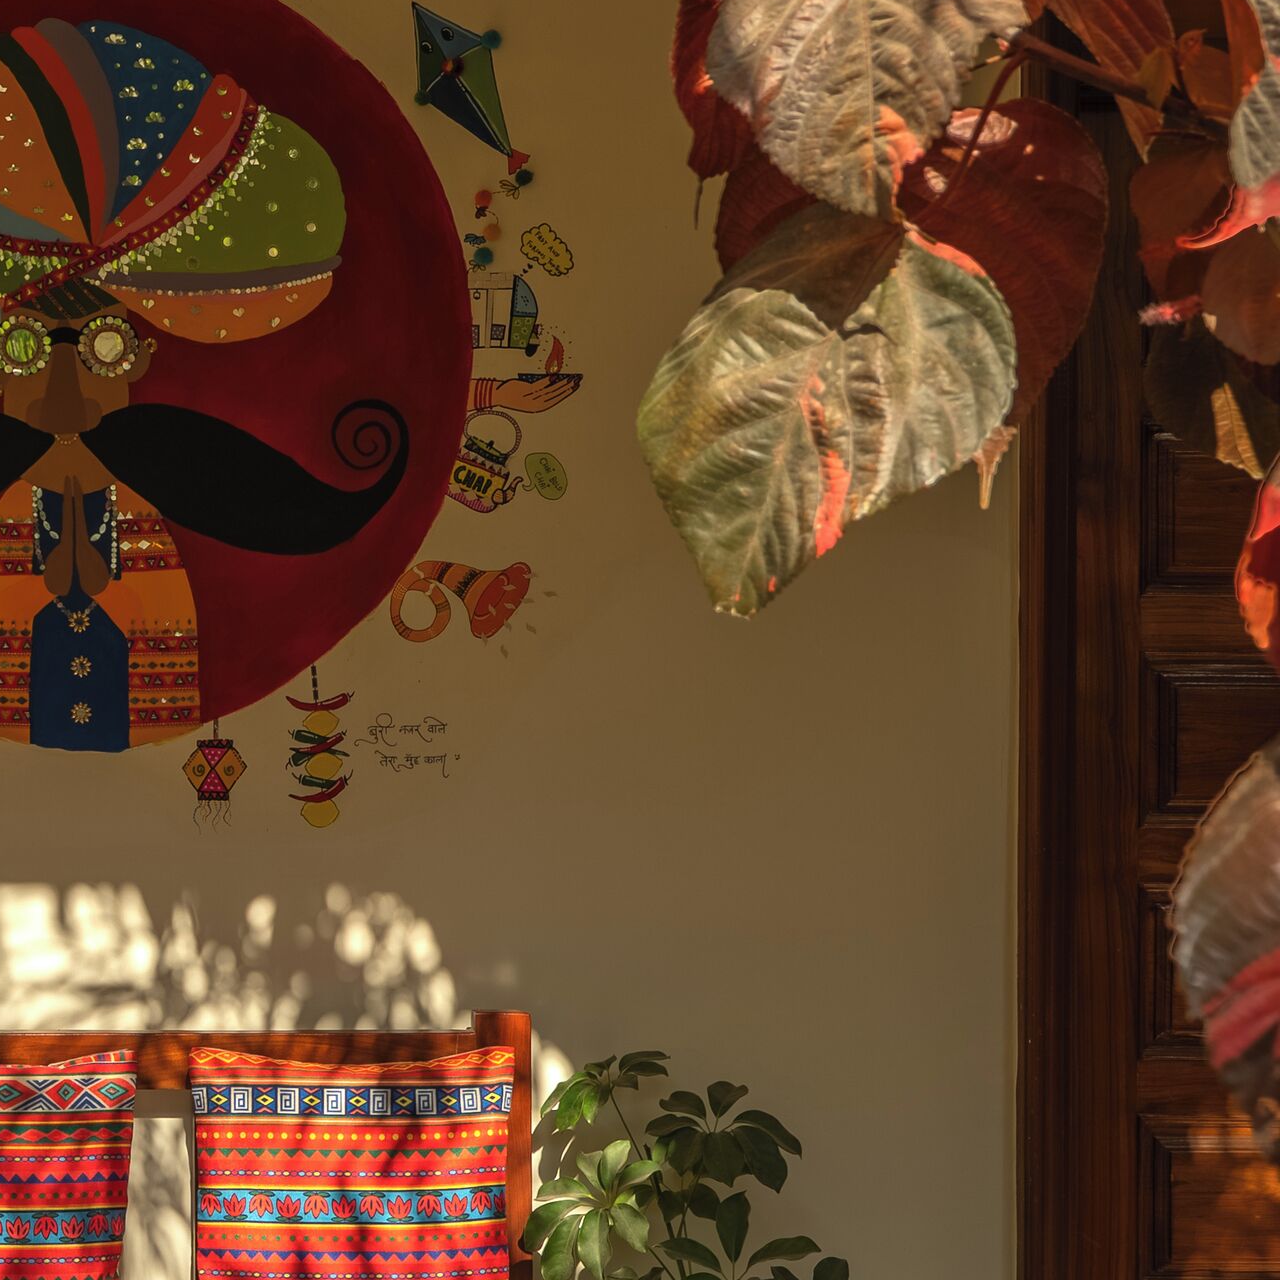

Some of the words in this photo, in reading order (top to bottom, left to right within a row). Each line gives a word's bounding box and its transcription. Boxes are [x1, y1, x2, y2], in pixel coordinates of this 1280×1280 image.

[453, 465, 492, 494] CHAI
[354, 712, 397, 747] बुरी
[423, 716, 448, 734] वाले
[374, 750, 400, 772] तेरा
